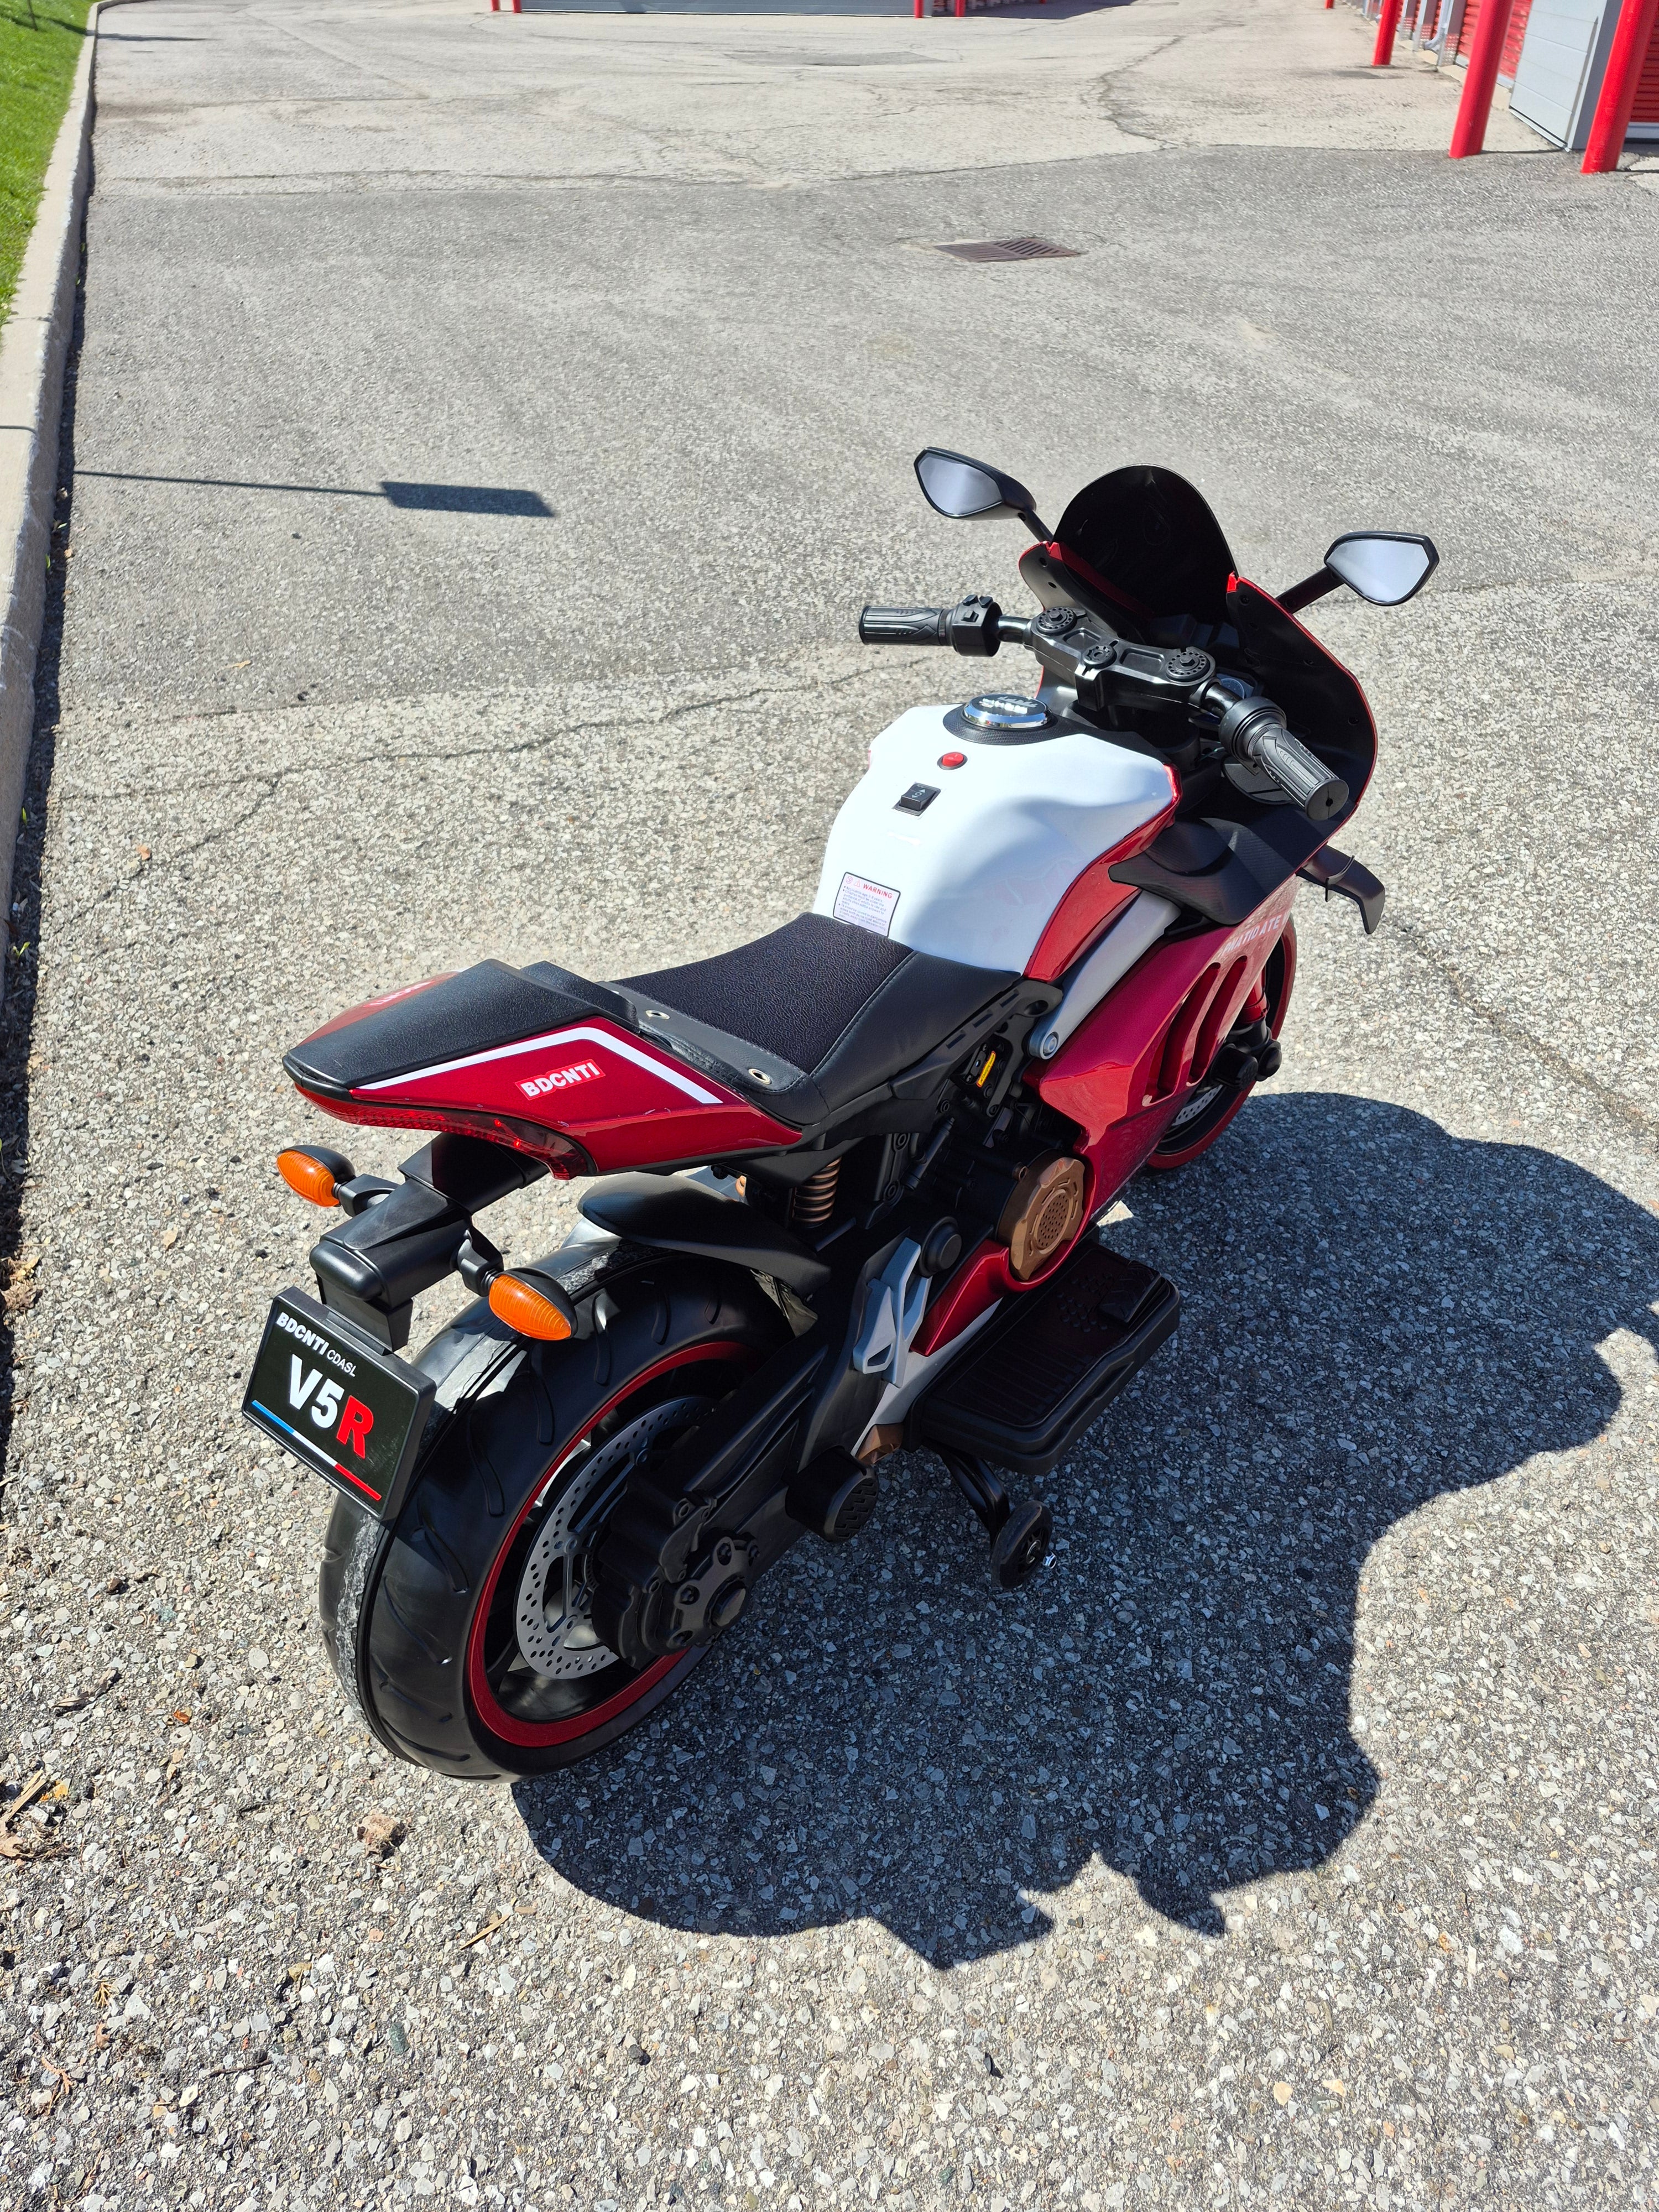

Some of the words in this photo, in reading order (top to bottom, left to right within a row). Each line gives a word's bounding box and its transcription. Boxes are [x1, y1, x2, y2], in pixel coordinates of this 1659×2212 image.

[863, 883, 893, 899] WARNING
[520, 1062, 600, 1097] BDCNTI
[276, 1312, 329, 1354] BDCNTI
[326, 1349, 356, 1377] CDASL
[290, 1354, 374, 1459] V5R
